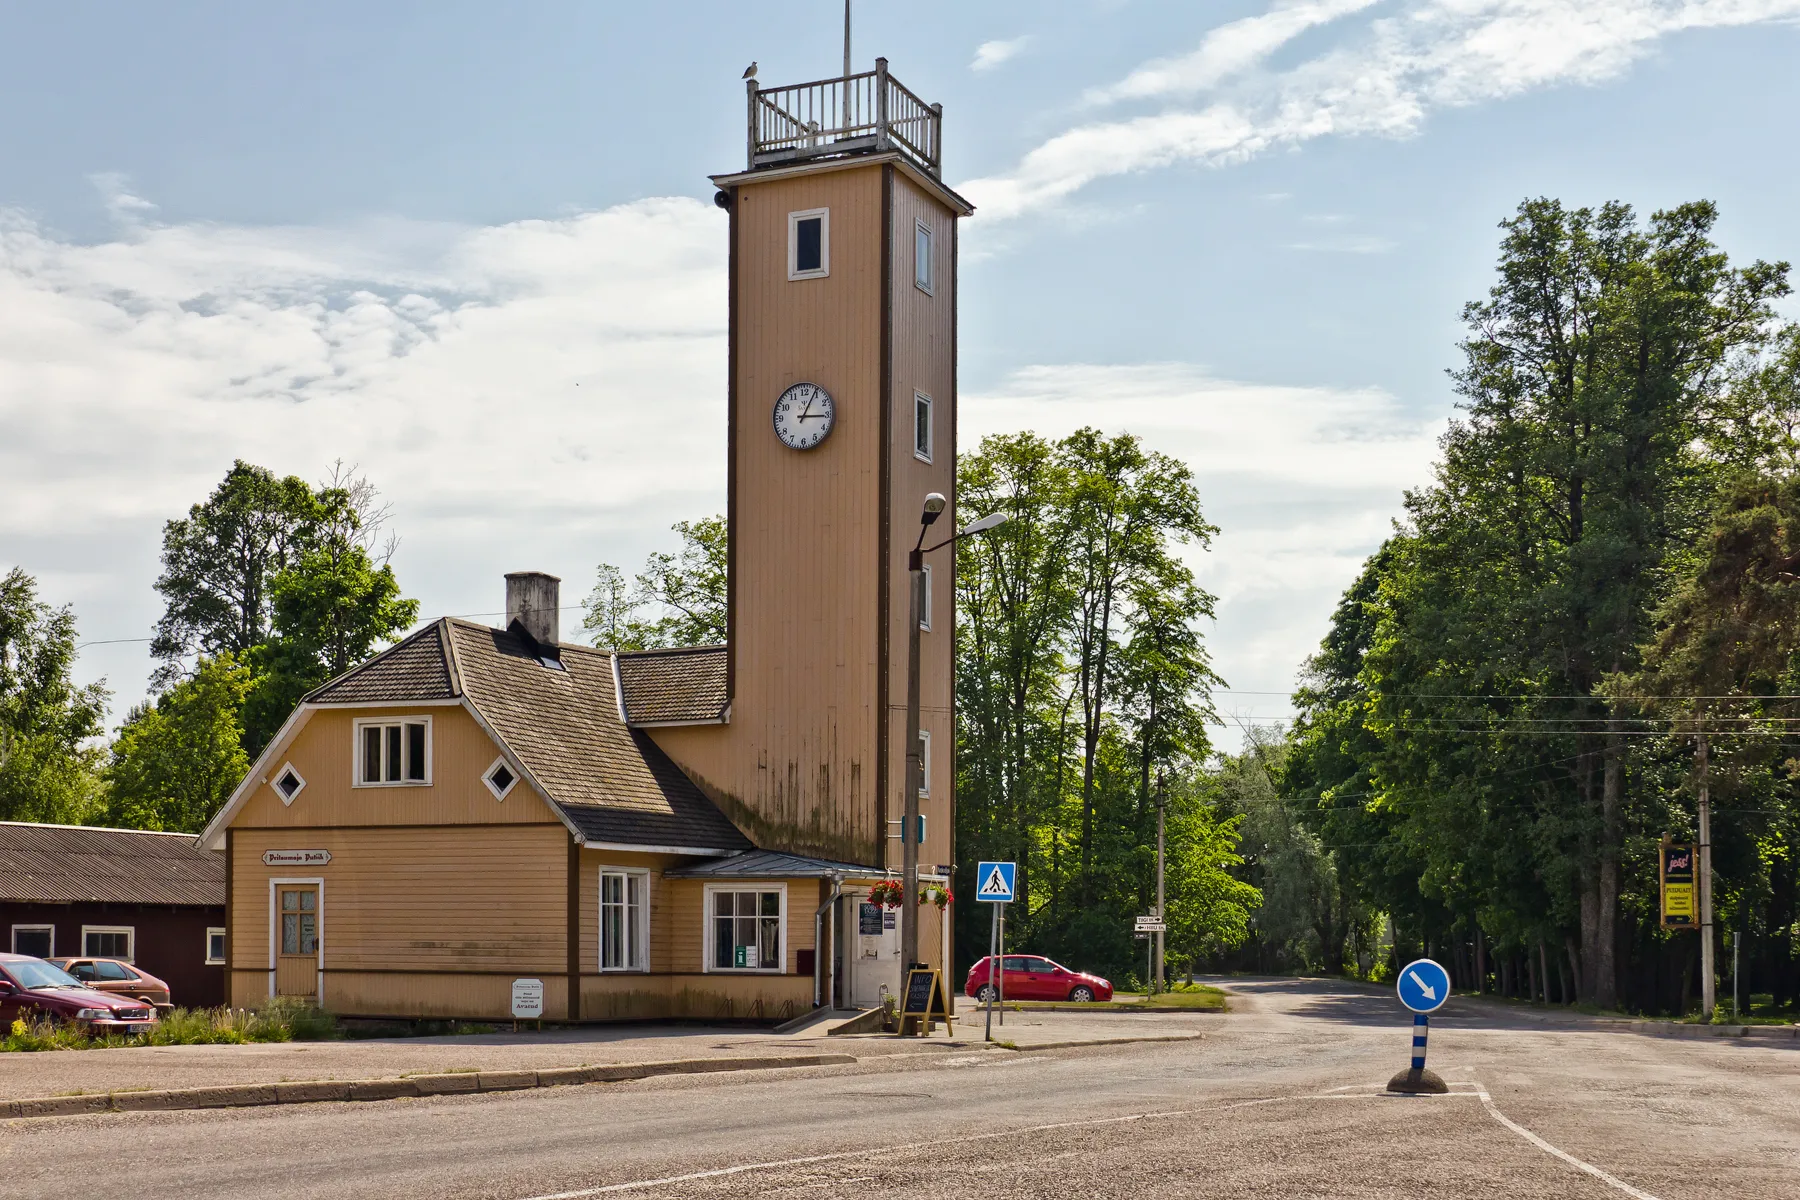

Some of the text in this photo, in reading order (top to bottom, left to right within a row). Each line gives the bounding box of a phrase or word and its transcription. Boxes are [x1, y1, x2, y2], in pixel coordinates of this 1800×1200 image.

[800, 388, 809, 396] 12
[815, 391, 819, 399] 1
[821, 399, 827, 407] 2
[824, 411, 830, 419] 3
[820, 423, 826, 431] 4
[789, 435, 795, 443] 7
[1667, 854, 1689, 873] jess!
[914, 974, 932, 984] INFO
